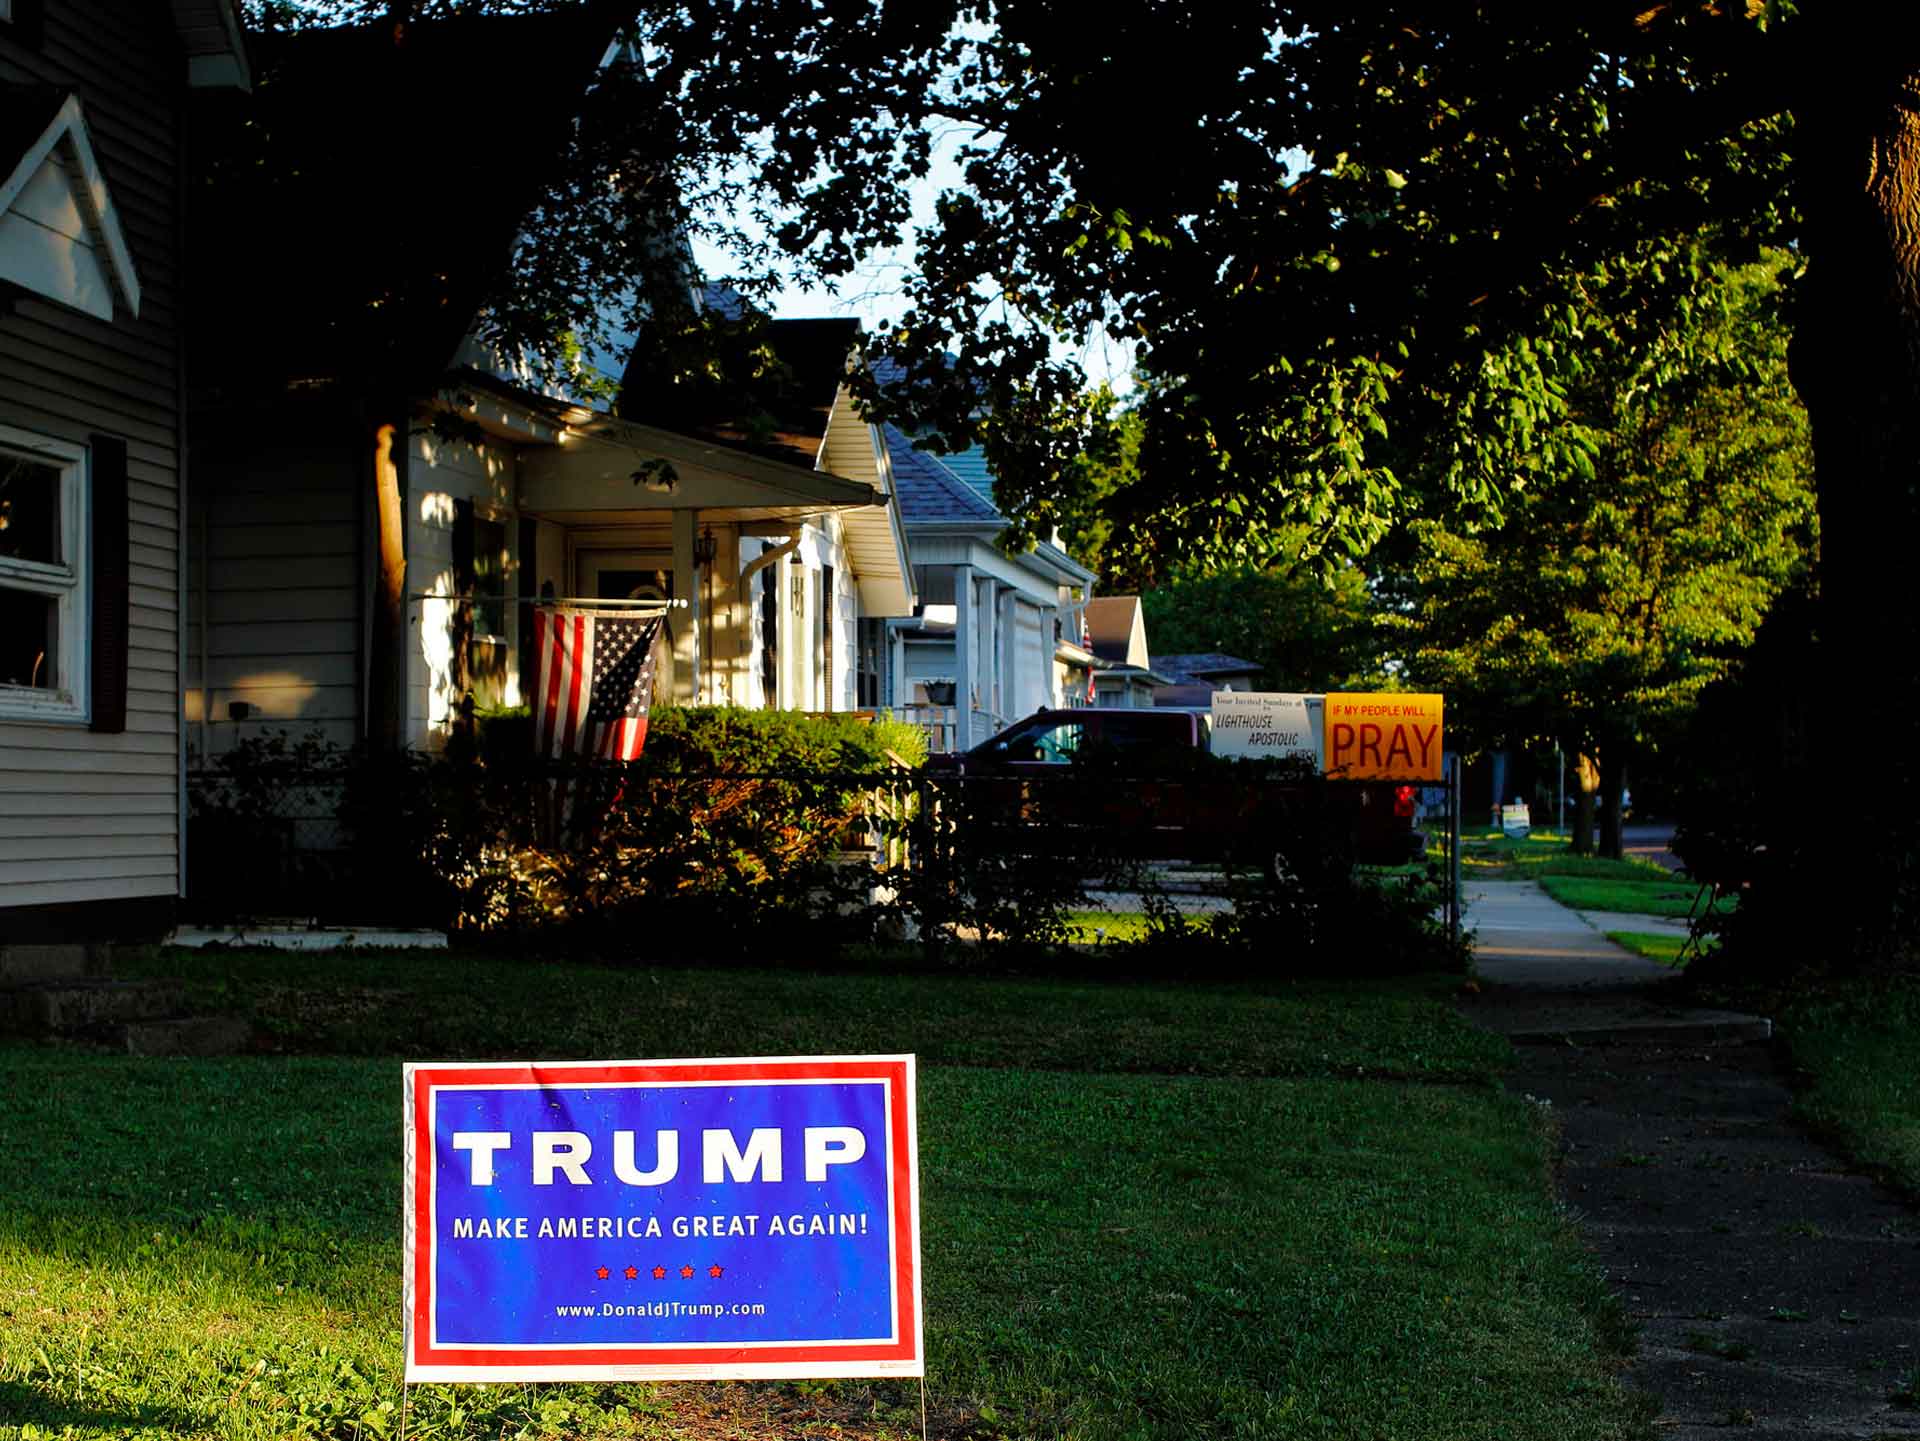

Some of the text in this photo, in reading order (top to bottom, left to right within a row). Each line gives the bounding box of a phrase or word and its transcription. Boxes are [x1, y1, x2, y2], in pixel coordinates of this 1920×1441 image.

[1333, 705, 1341, 716] IF
[1344, 705, 1358, 716] MY
[1360, 705, 1400, 716] PEOPLE
[1216, 714, 1272, 728] LIGHTHOUSE
[1248, 732, 1298, 746] APOSTOLIC
[1332, 723, 1438, 769] PRAY
[452, 1126, 867, 1187] TRUMP
[453, 1213, 869, 1239] MAKE AMERICA GREAT AGAIN!
[556, 1302, 766, 1319] www.DonaldJTrump.com
